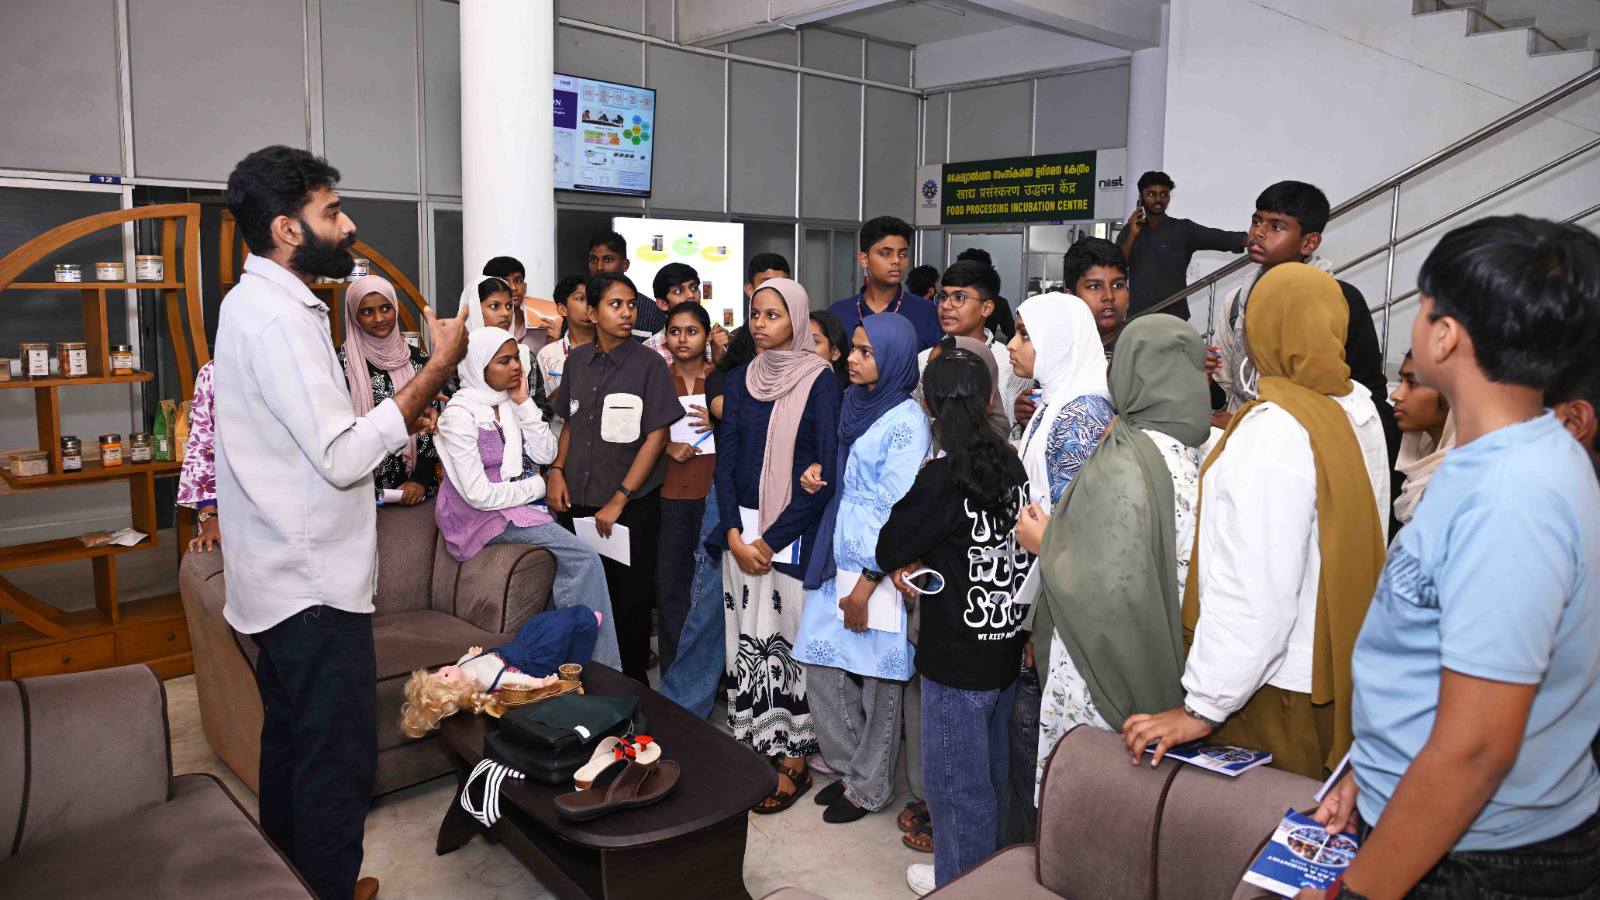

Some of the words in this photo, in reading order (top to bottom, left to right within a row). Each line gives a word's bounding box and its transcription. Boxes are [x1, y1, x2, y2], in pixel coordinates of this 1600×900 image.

[955, 188, 977, 199] खाद्य
[979, 184, 1020, 199] प्रसंस्करण
[946, 205, 964, 216] FOOD
[965, 203, 1009, 215] PROCESSING
[1010, 201, 1055, 213] INCUBATION
[1057, 199, 1088, 211] CENTRE
[989, 632, 1005, 640] KEEP
